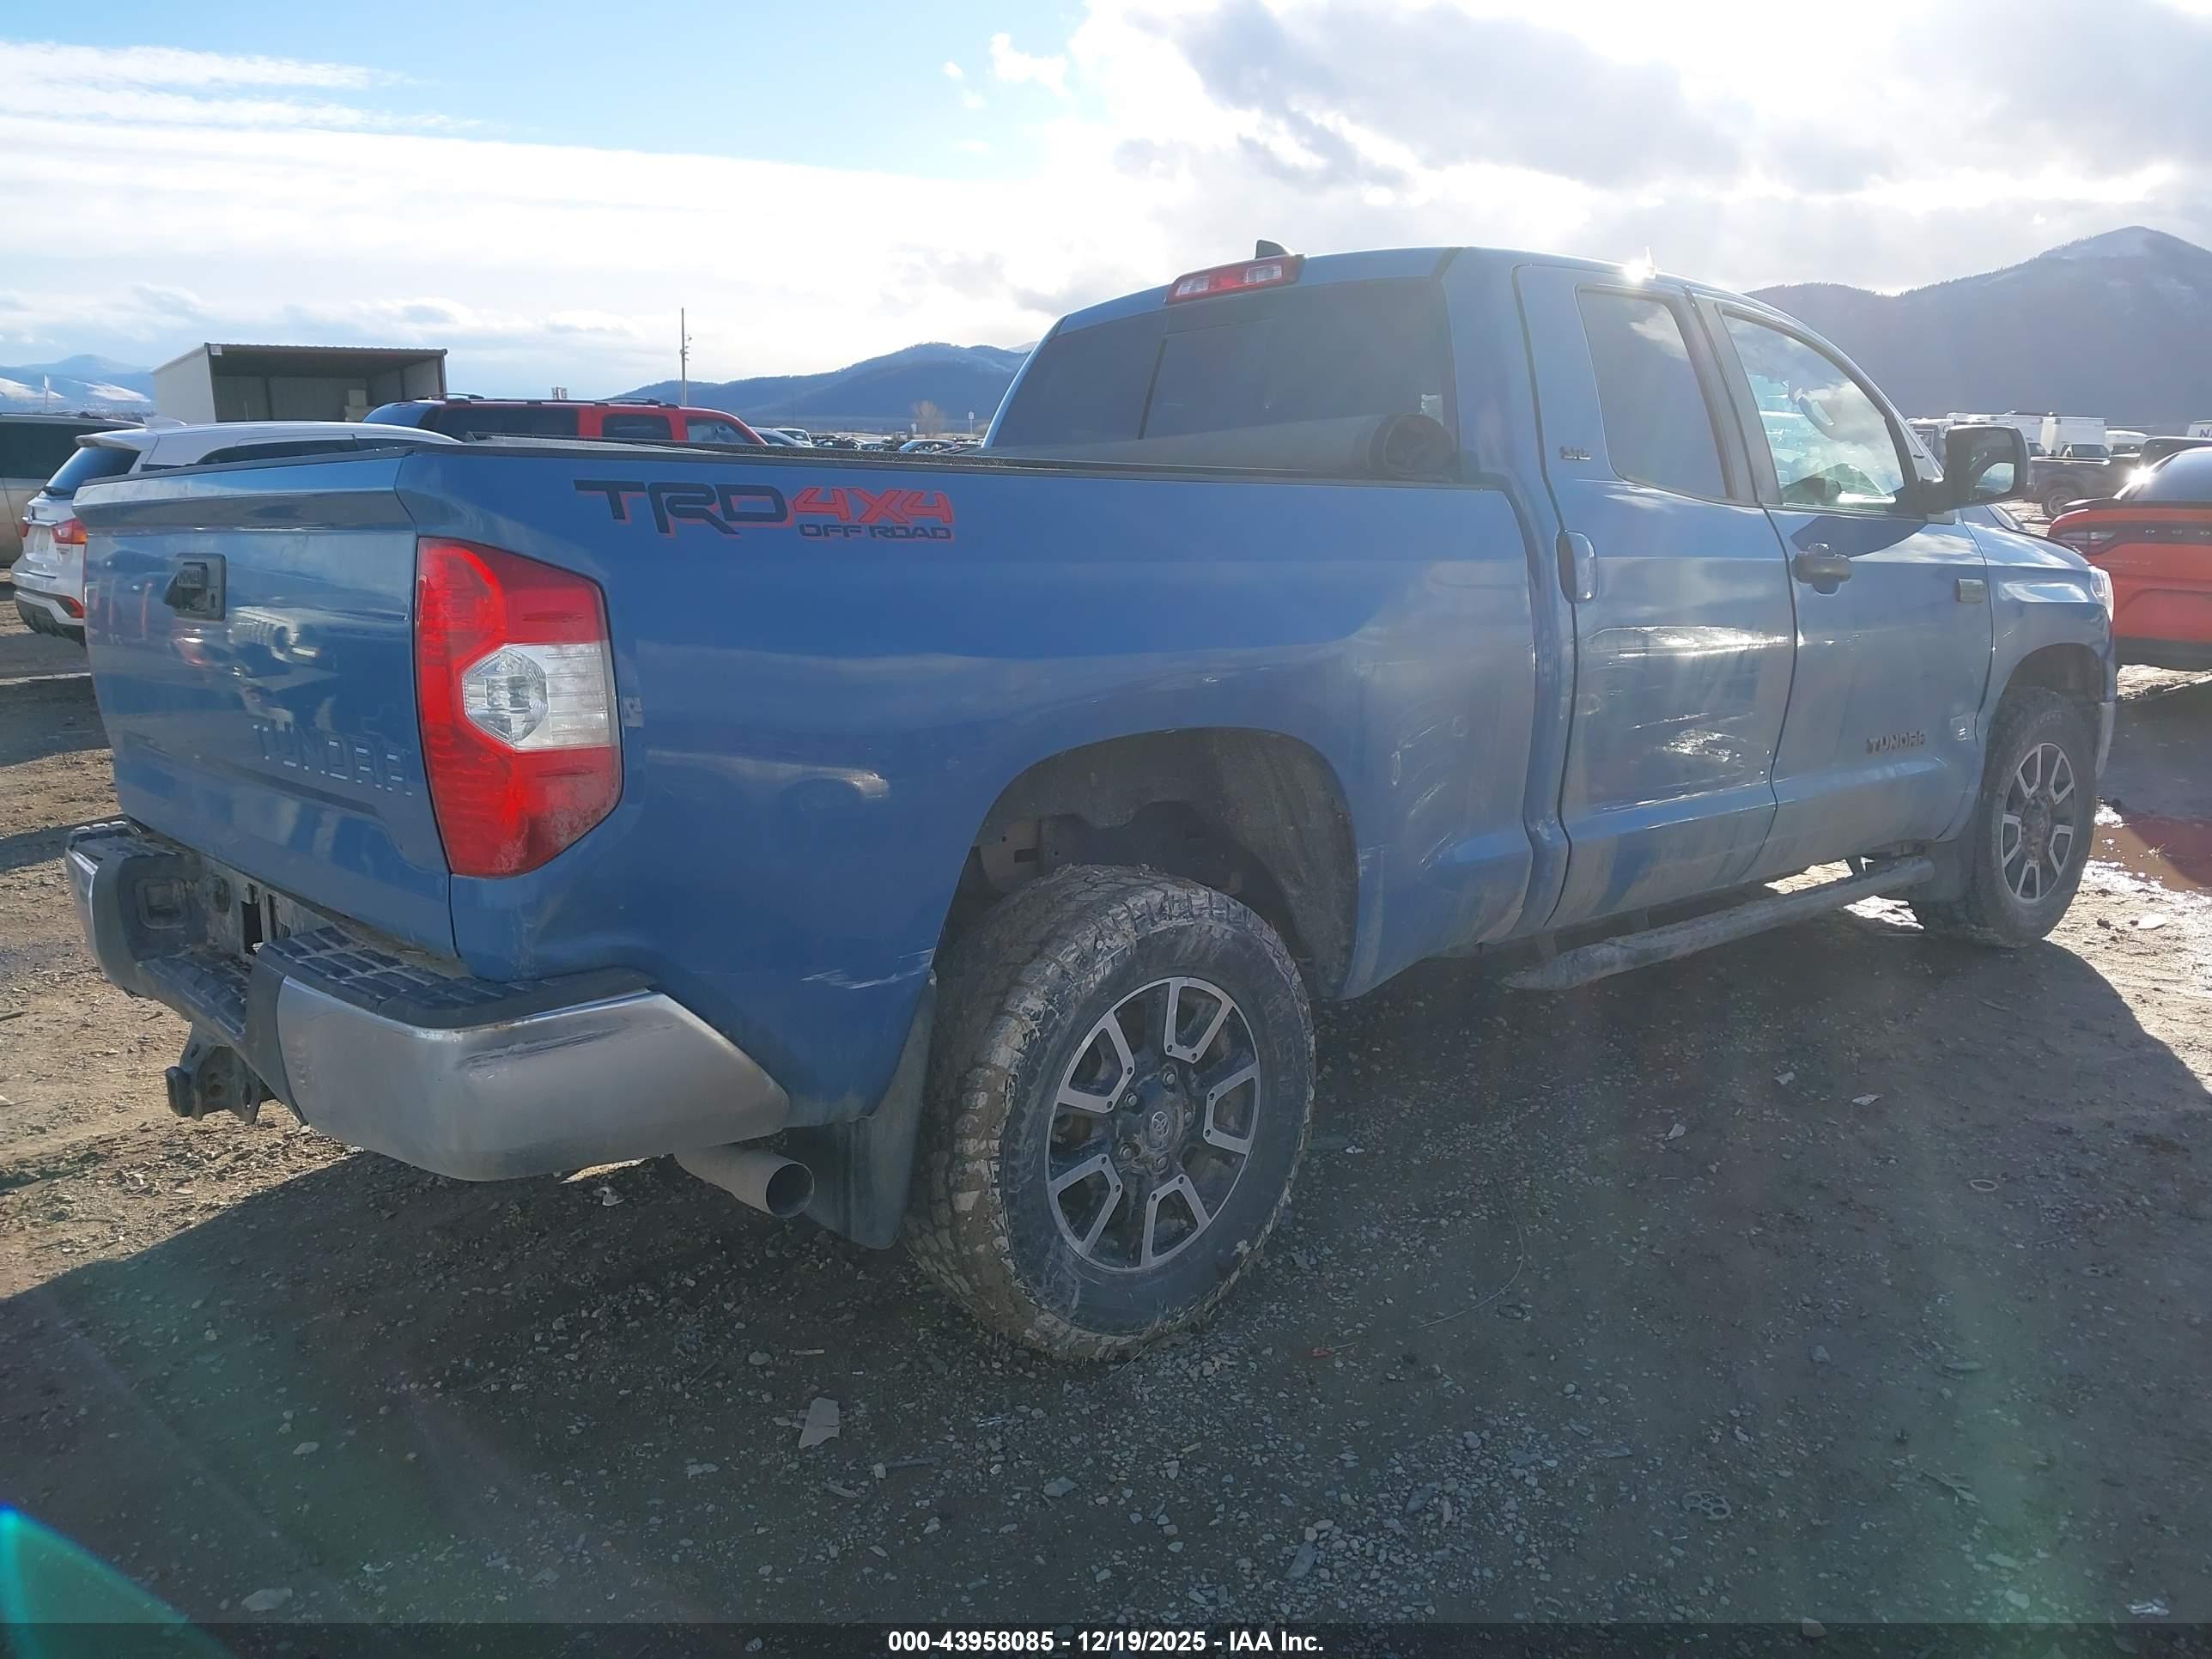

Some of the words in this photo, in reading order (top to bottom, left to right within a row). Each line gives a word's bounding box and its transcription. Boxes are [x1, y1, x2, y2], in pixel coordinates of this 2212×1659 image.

[573, 479, 793, 538] TRD
[799, 524, 862, 538] OFF
[868, 525, 953, 540] ROAD
